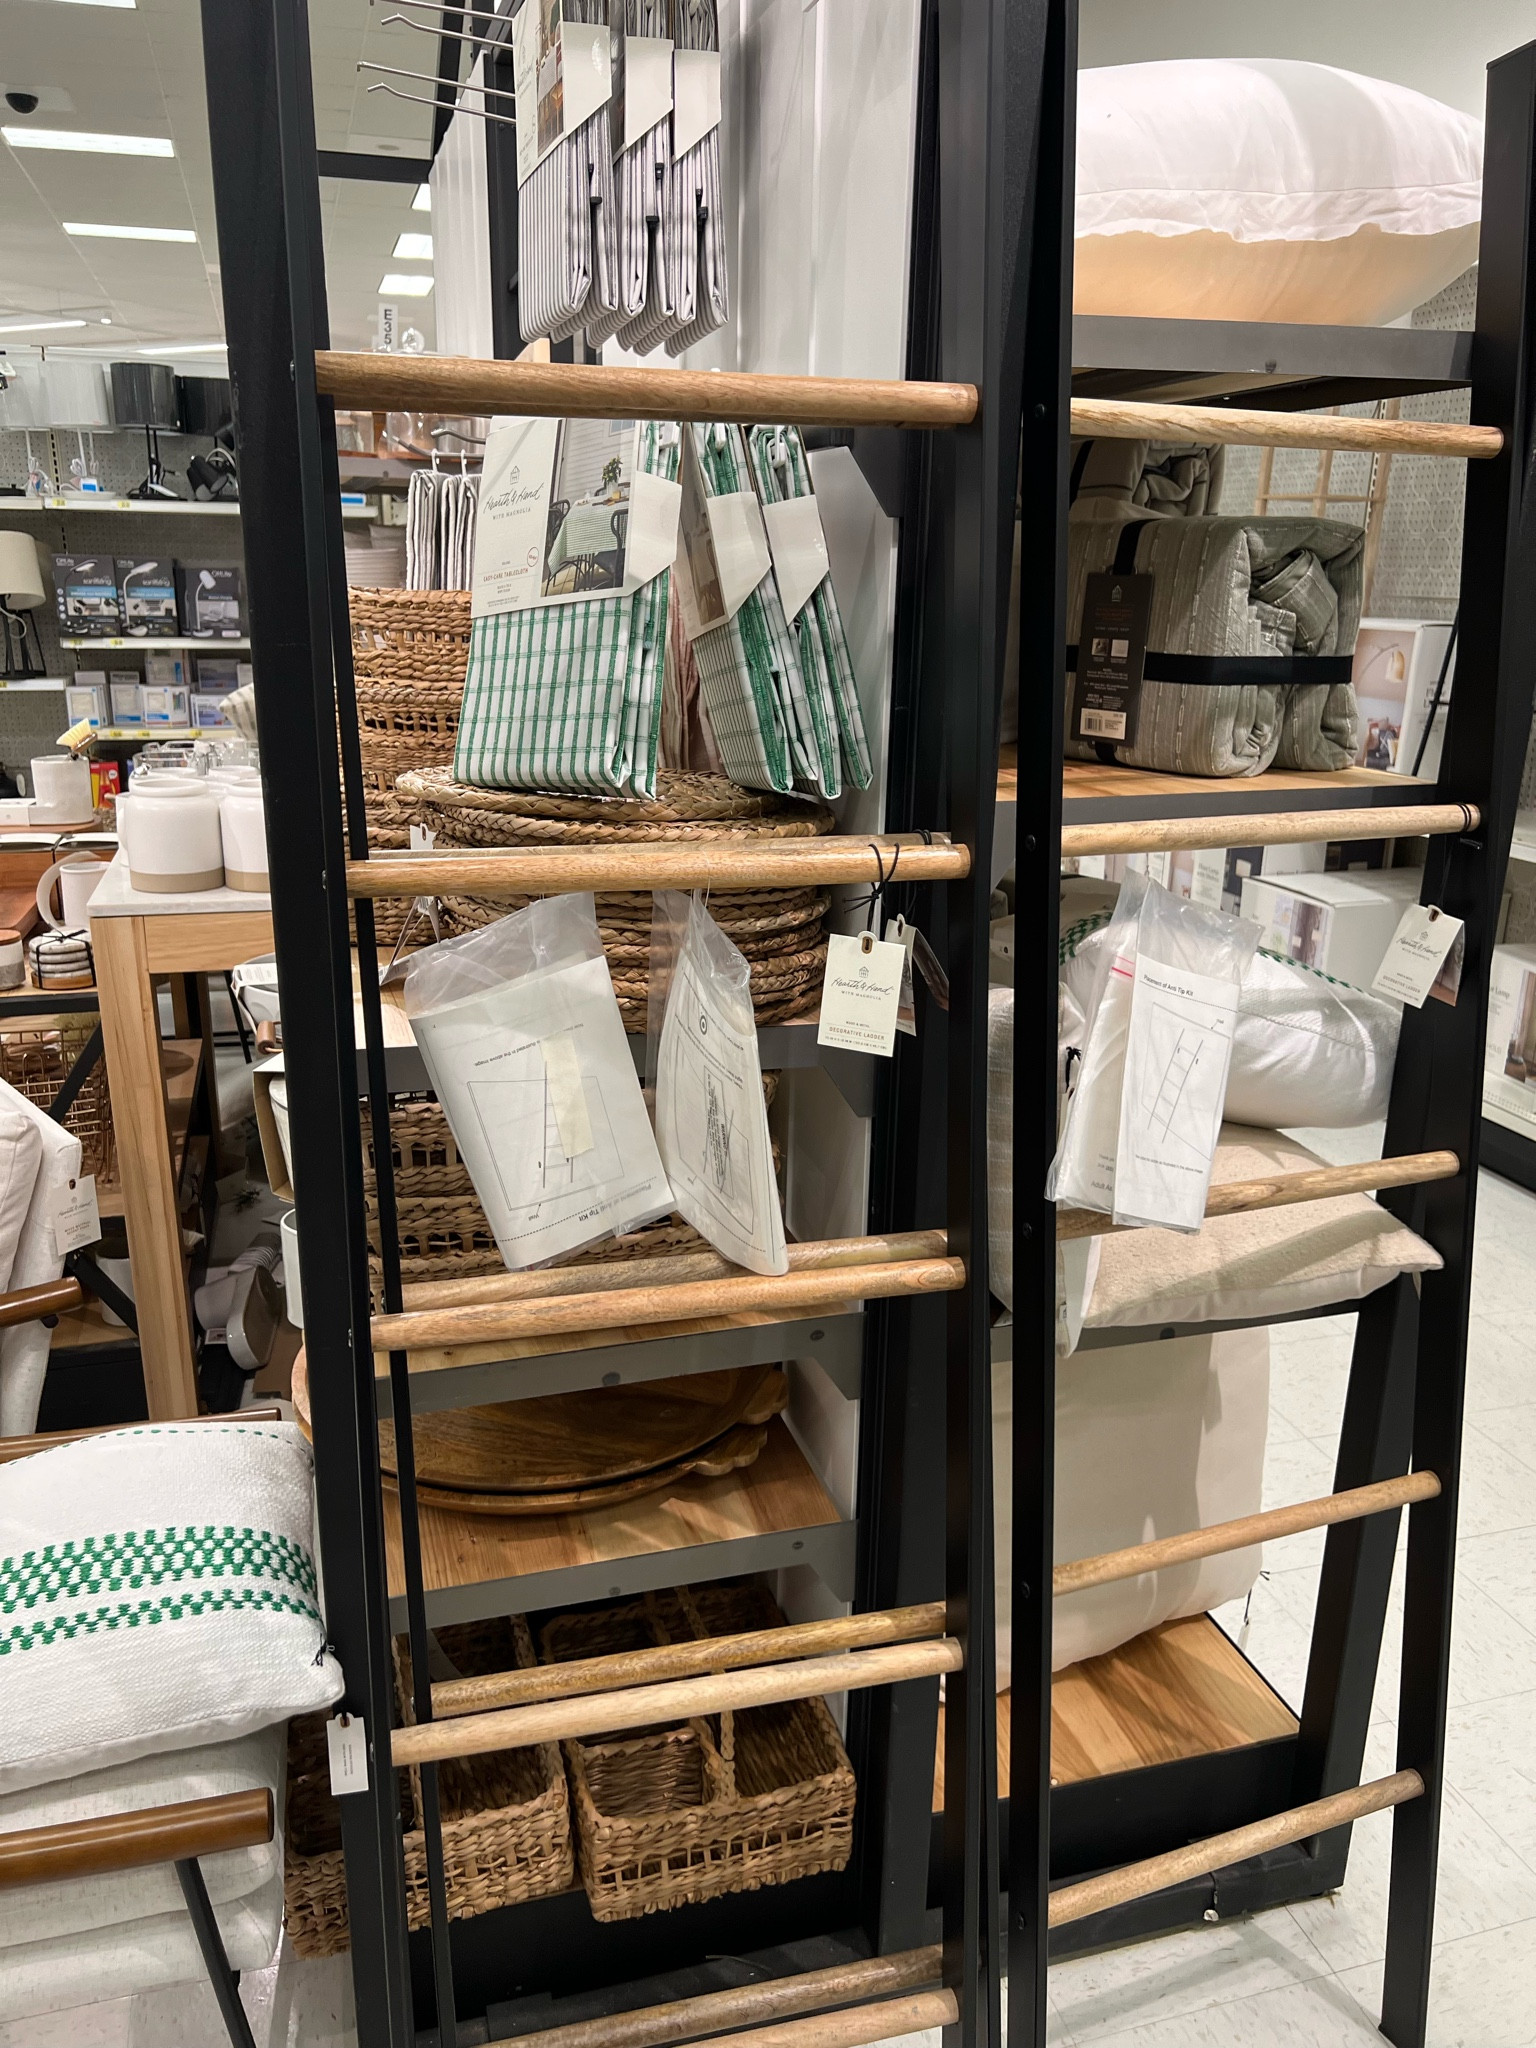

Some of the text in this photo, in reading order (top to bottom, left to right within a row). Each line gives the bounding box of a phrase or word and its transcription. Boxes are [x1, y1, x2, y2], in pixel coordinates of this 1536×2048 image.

[384, 309, 392, 345] E35
[483, 488, 513, 514] Hearth
[516, 482, 544, 503] Hand
[831, 977, 862, 989] Hearth
[866, 983, 893, 996] Hand
[1143, 974, 1162, 986] Placement
[1167, 984, 1176, 992] Anti
[829, 1026, 885, 1041] DECORATIVE LADDER
[528, 1213, 539, 1221] Wall
[579, 1213, 589, 1221] Kit
